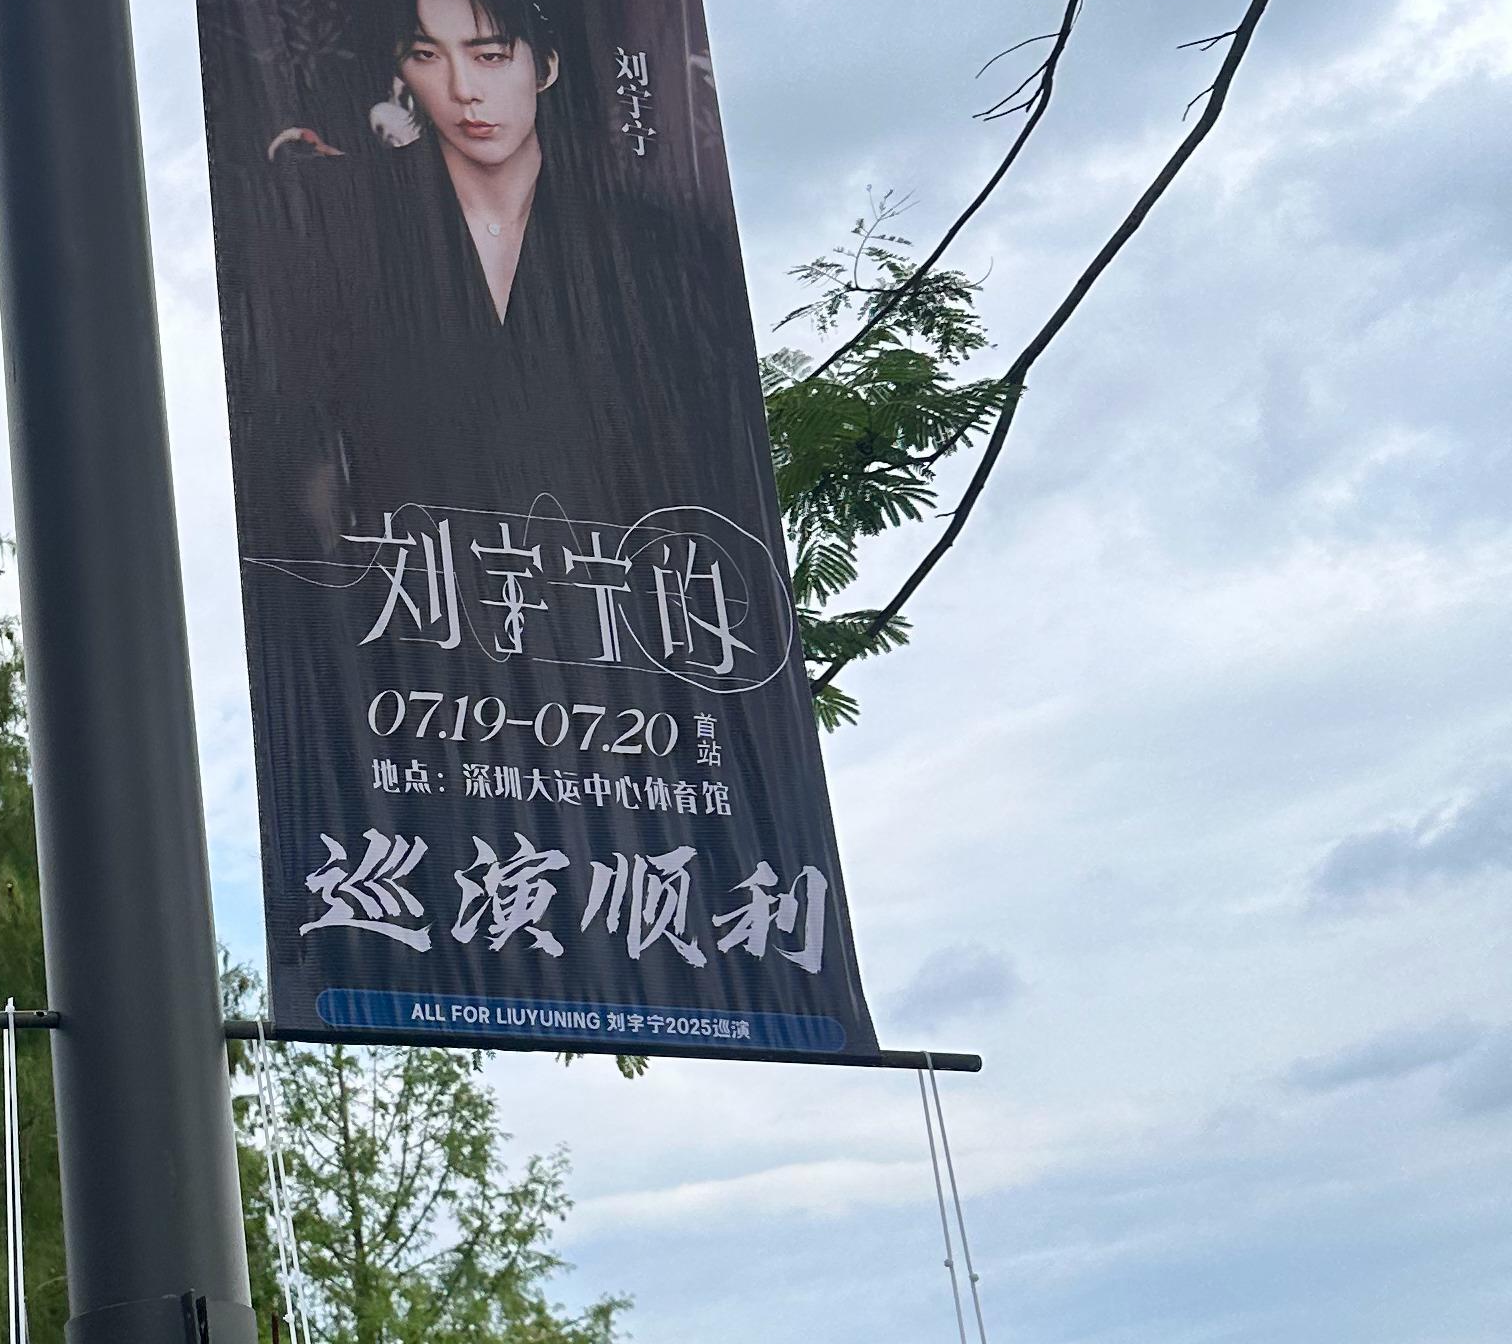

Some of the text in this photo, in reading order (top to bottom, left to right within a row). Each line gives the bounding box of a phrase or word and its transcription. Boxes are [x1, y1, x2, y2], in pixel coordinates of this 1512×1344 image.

[615, 46, 657, 157] 刘宇宁
[340, 512, 757, 675] 刘宇宁的
[693, 712, 722, 768] 首站
[299, 827, 829, 974] 巡演顺利
[411, 1002, 751, 1040] ALL FOR LIUYUNING 刘宇宁2025巡演
